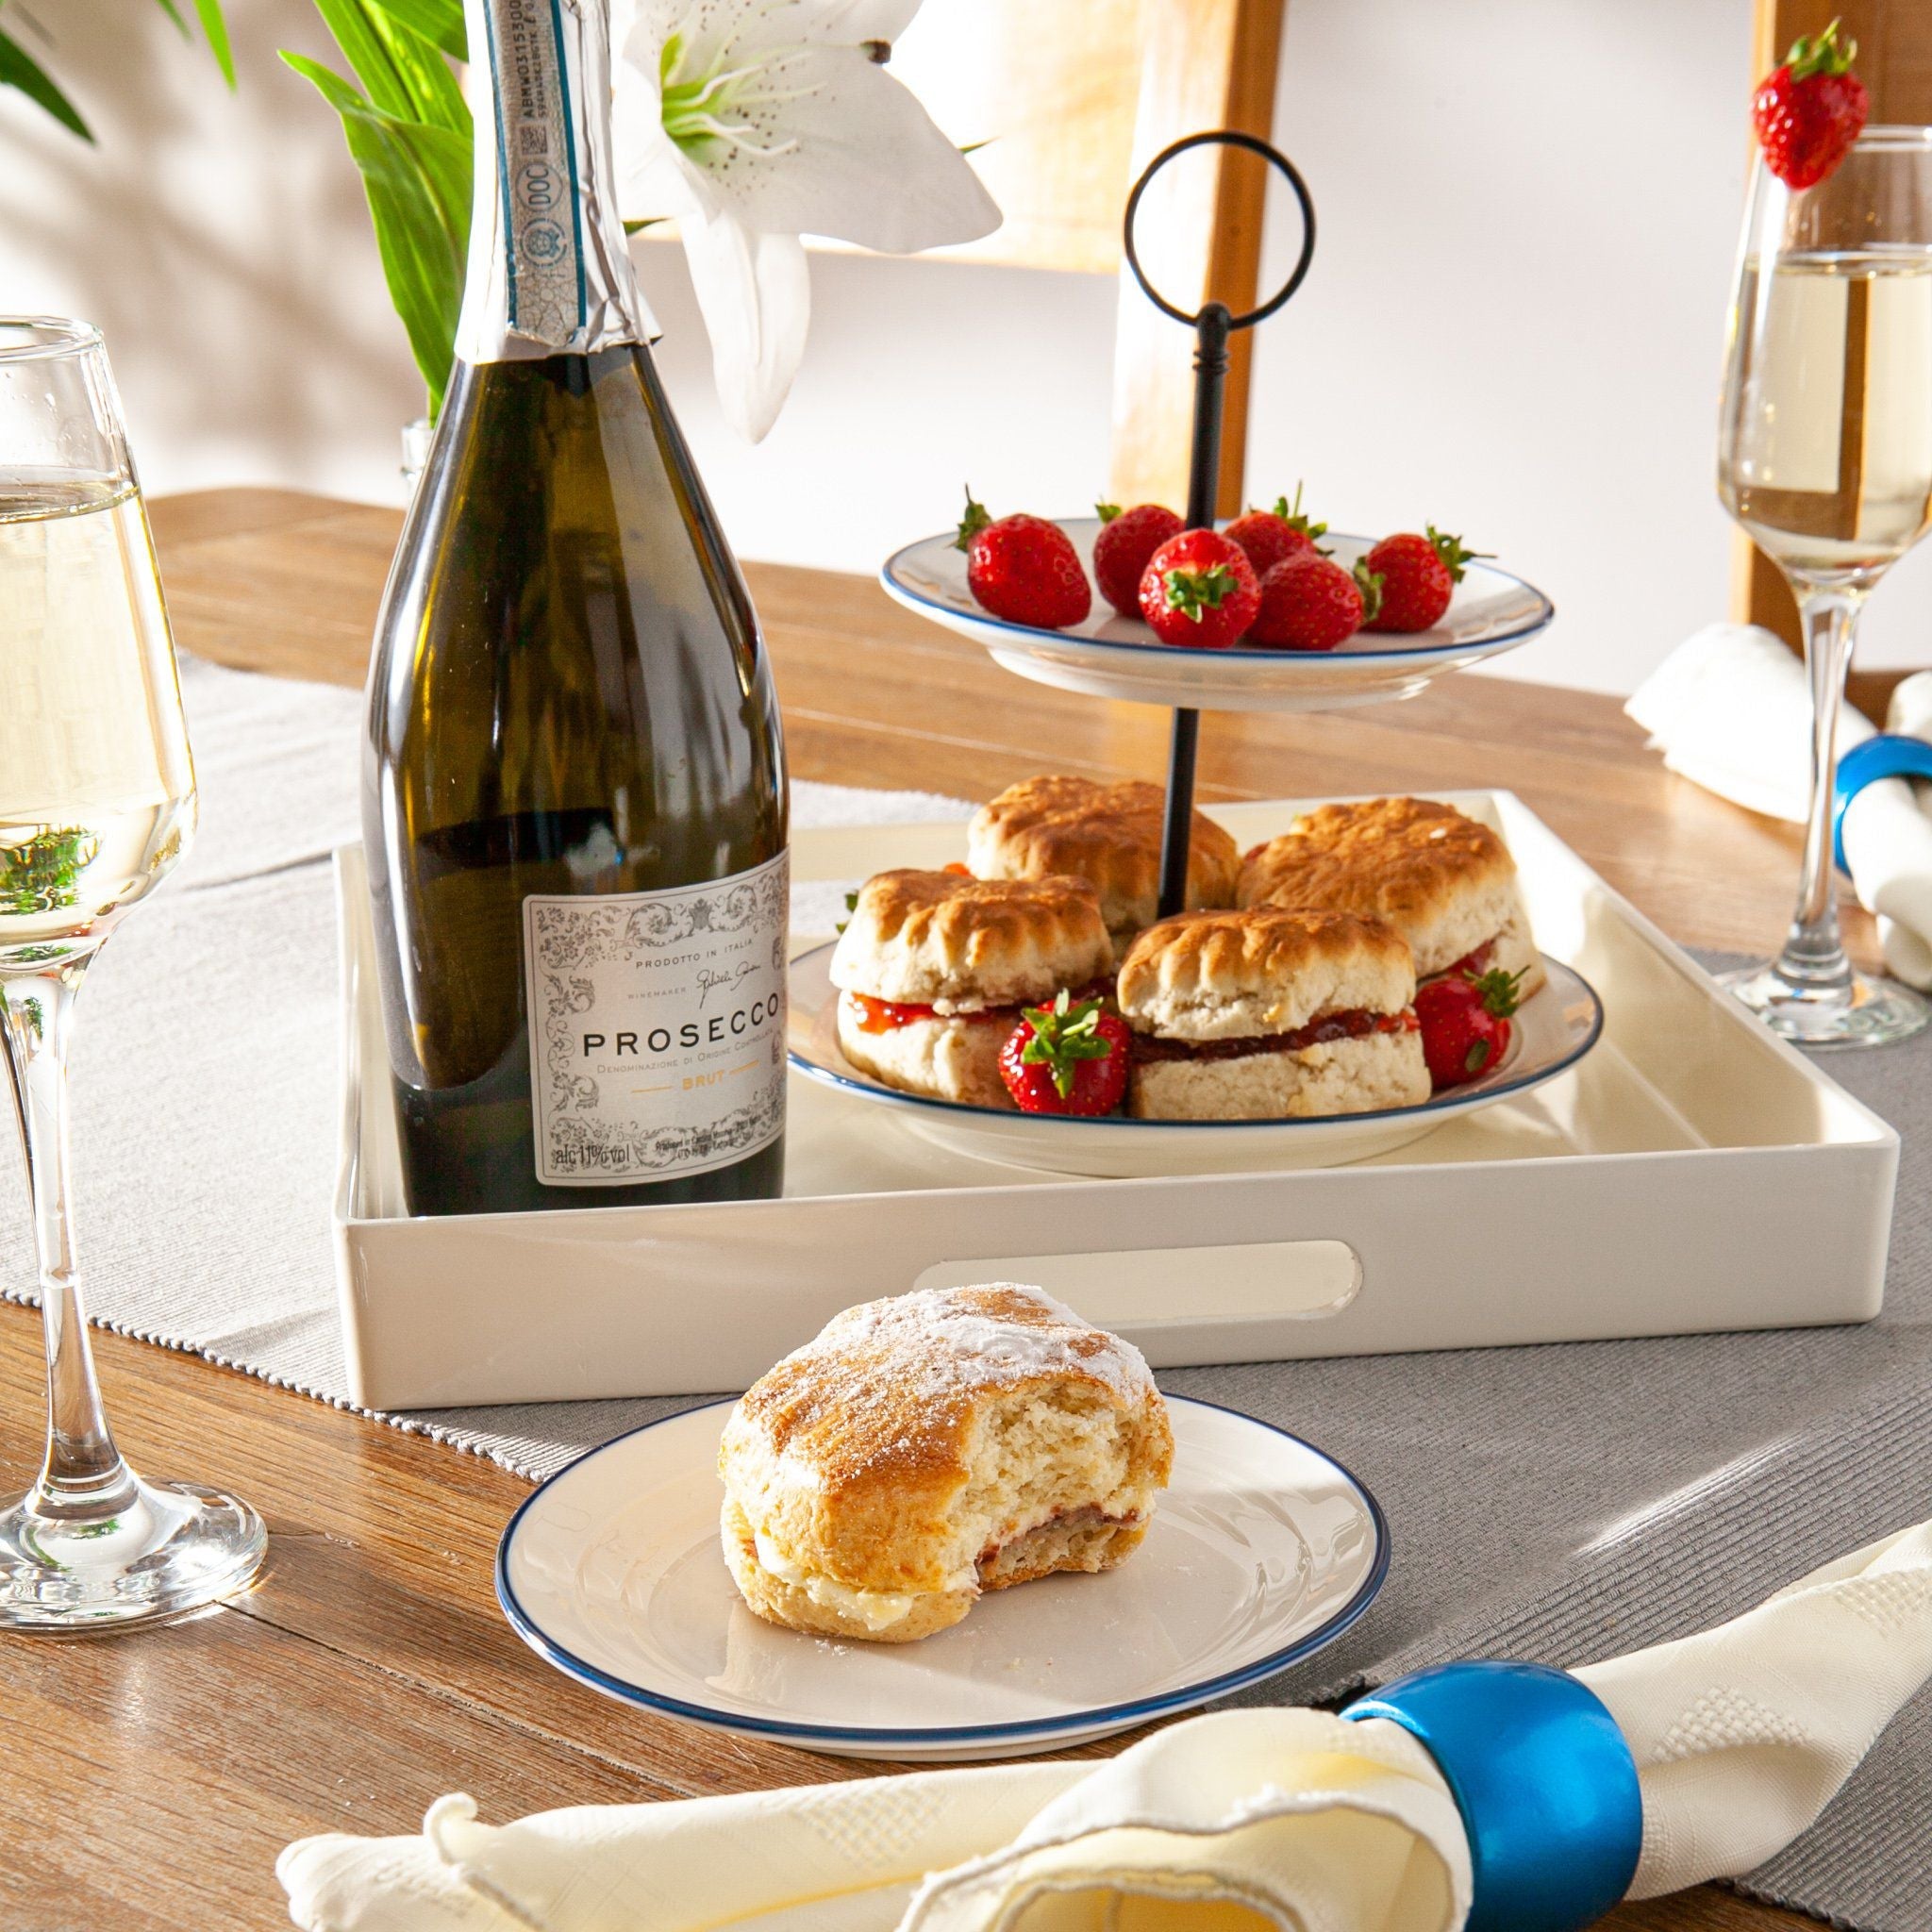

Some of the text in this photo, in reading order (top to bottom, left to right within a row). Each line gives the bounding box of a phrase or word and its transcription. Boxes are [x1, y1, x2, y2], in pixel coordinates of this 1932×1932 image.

[526, 165, 551, 205] DOC
[636, 953, 700, 969] PRODOTTO
[724, 939, 753, 953] ITALIA
[627, 987, 687, 1000] WINEMAKER
[584, 992, 778, 1057] PROSECCO
[682, 1069, 724, 1091] BRUT
[556, 1143, 576, 1164] alc
[610, 1143, 630, 1163] vol
